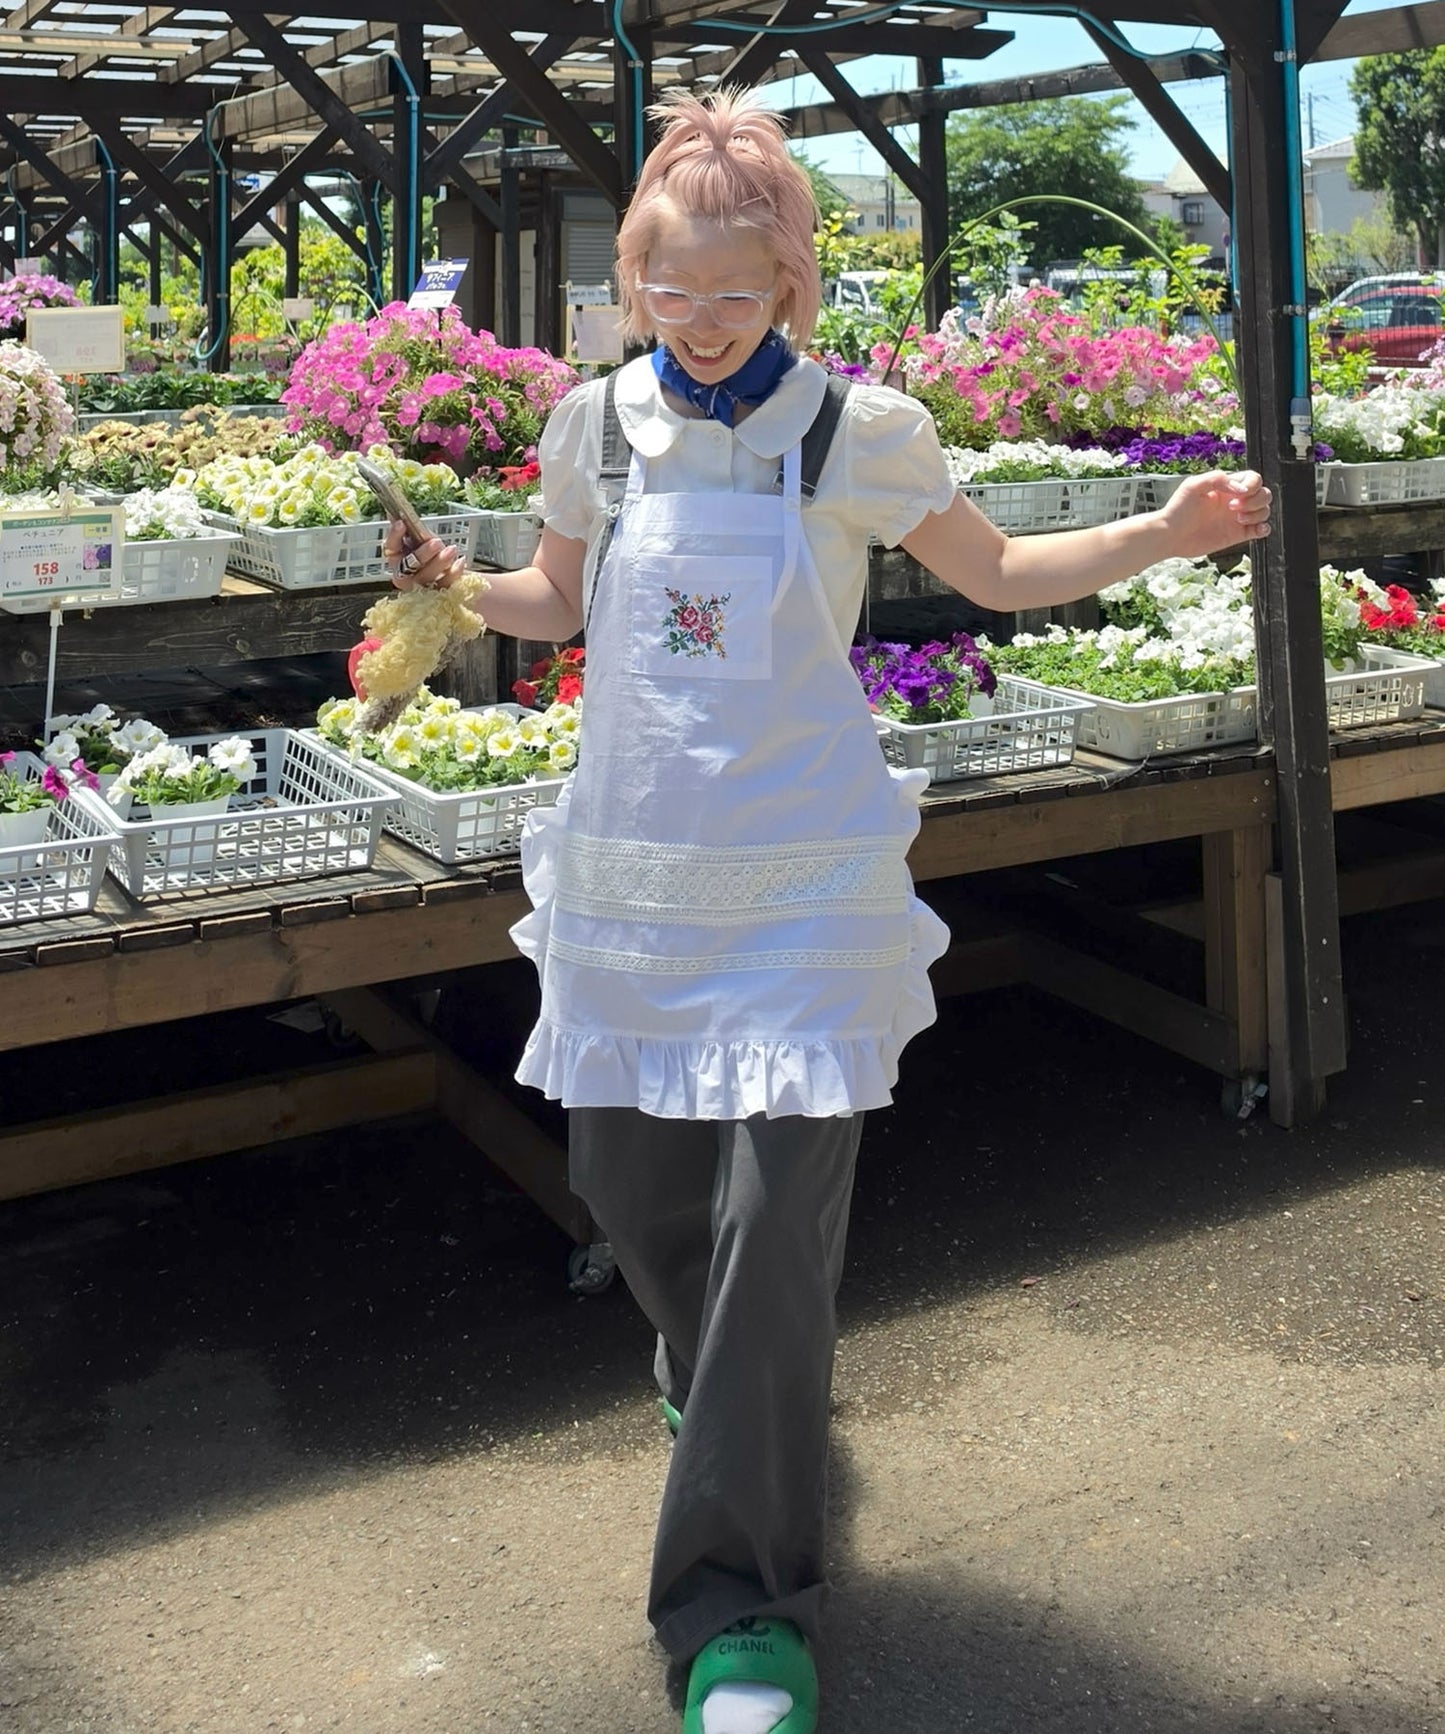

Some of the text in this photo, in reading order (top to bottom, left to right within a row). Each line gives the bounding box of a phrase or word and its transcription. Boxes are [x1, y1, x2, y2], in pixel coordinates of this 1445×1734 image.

[33, 562, 59, 575] 158
[38, 577, 53, 585] 173
[718, 1640, 776, 1655] CHANEL
